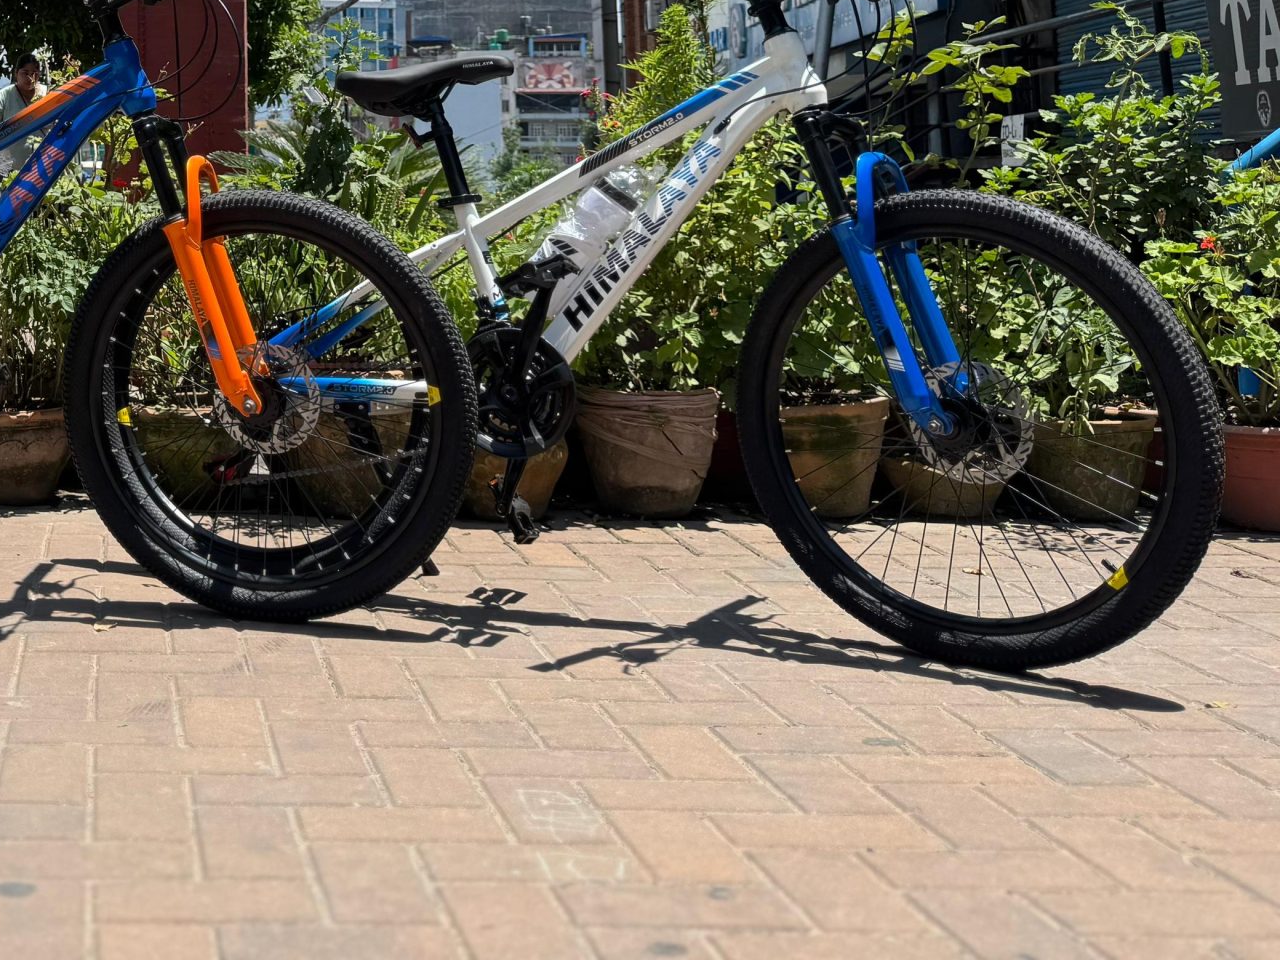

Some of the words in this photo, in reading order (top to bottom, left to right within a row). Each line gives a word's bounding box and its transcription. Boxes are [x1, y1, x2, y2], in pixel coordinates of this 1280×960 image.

[462, 60, 494, 69] HIMALAYA
[629, 112, 684, 147] STORM2.0
[562, 140, 722, 332] HIMALAYA
[187, 279, 208, 327] HIMALAYA
[333, 383, 394, 395] STORM2.0
